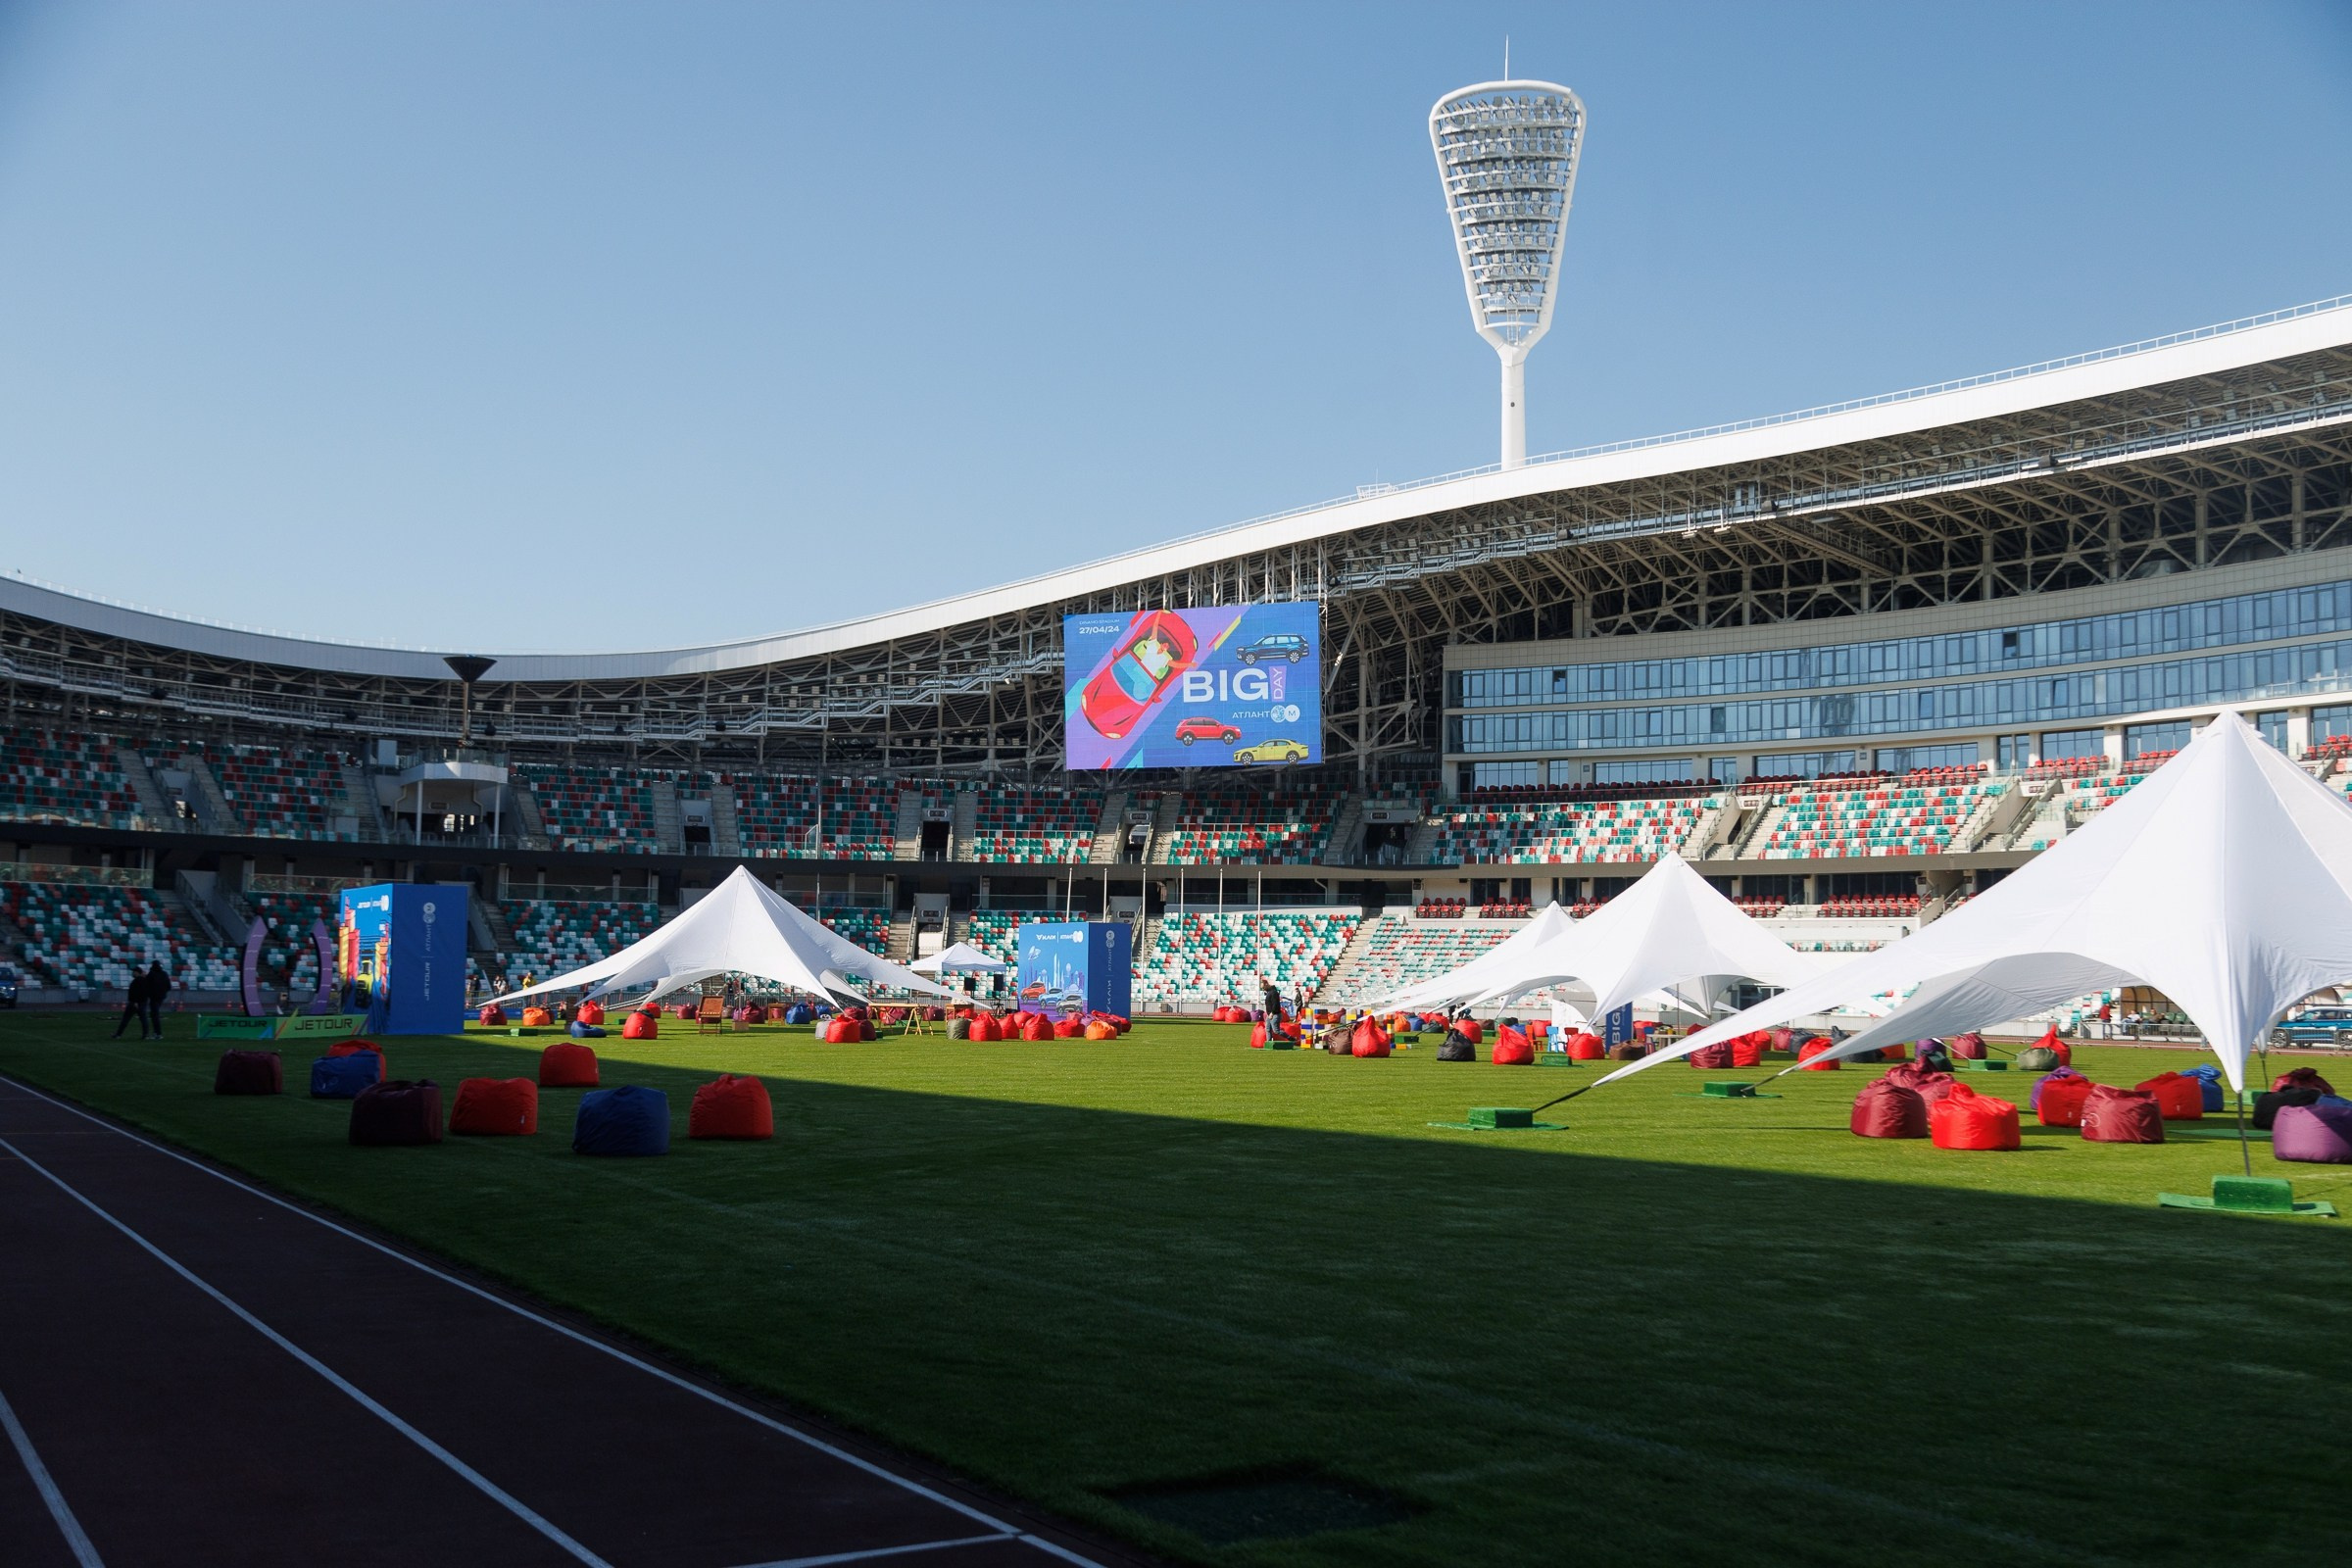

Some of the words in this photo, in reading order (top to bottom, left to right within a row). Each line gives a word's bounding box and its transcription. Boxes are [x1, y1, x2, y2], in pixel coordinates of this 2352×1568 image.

[1079, 625, 1120, 635] 27/04/24
[1183, 668, 1269, 703] BIG
[1274, 667, 1283, 700] DAY
[1232, 710, 1271, 719] АТЛАНТ
[294, 1017, 354, 1031] JETOUR
